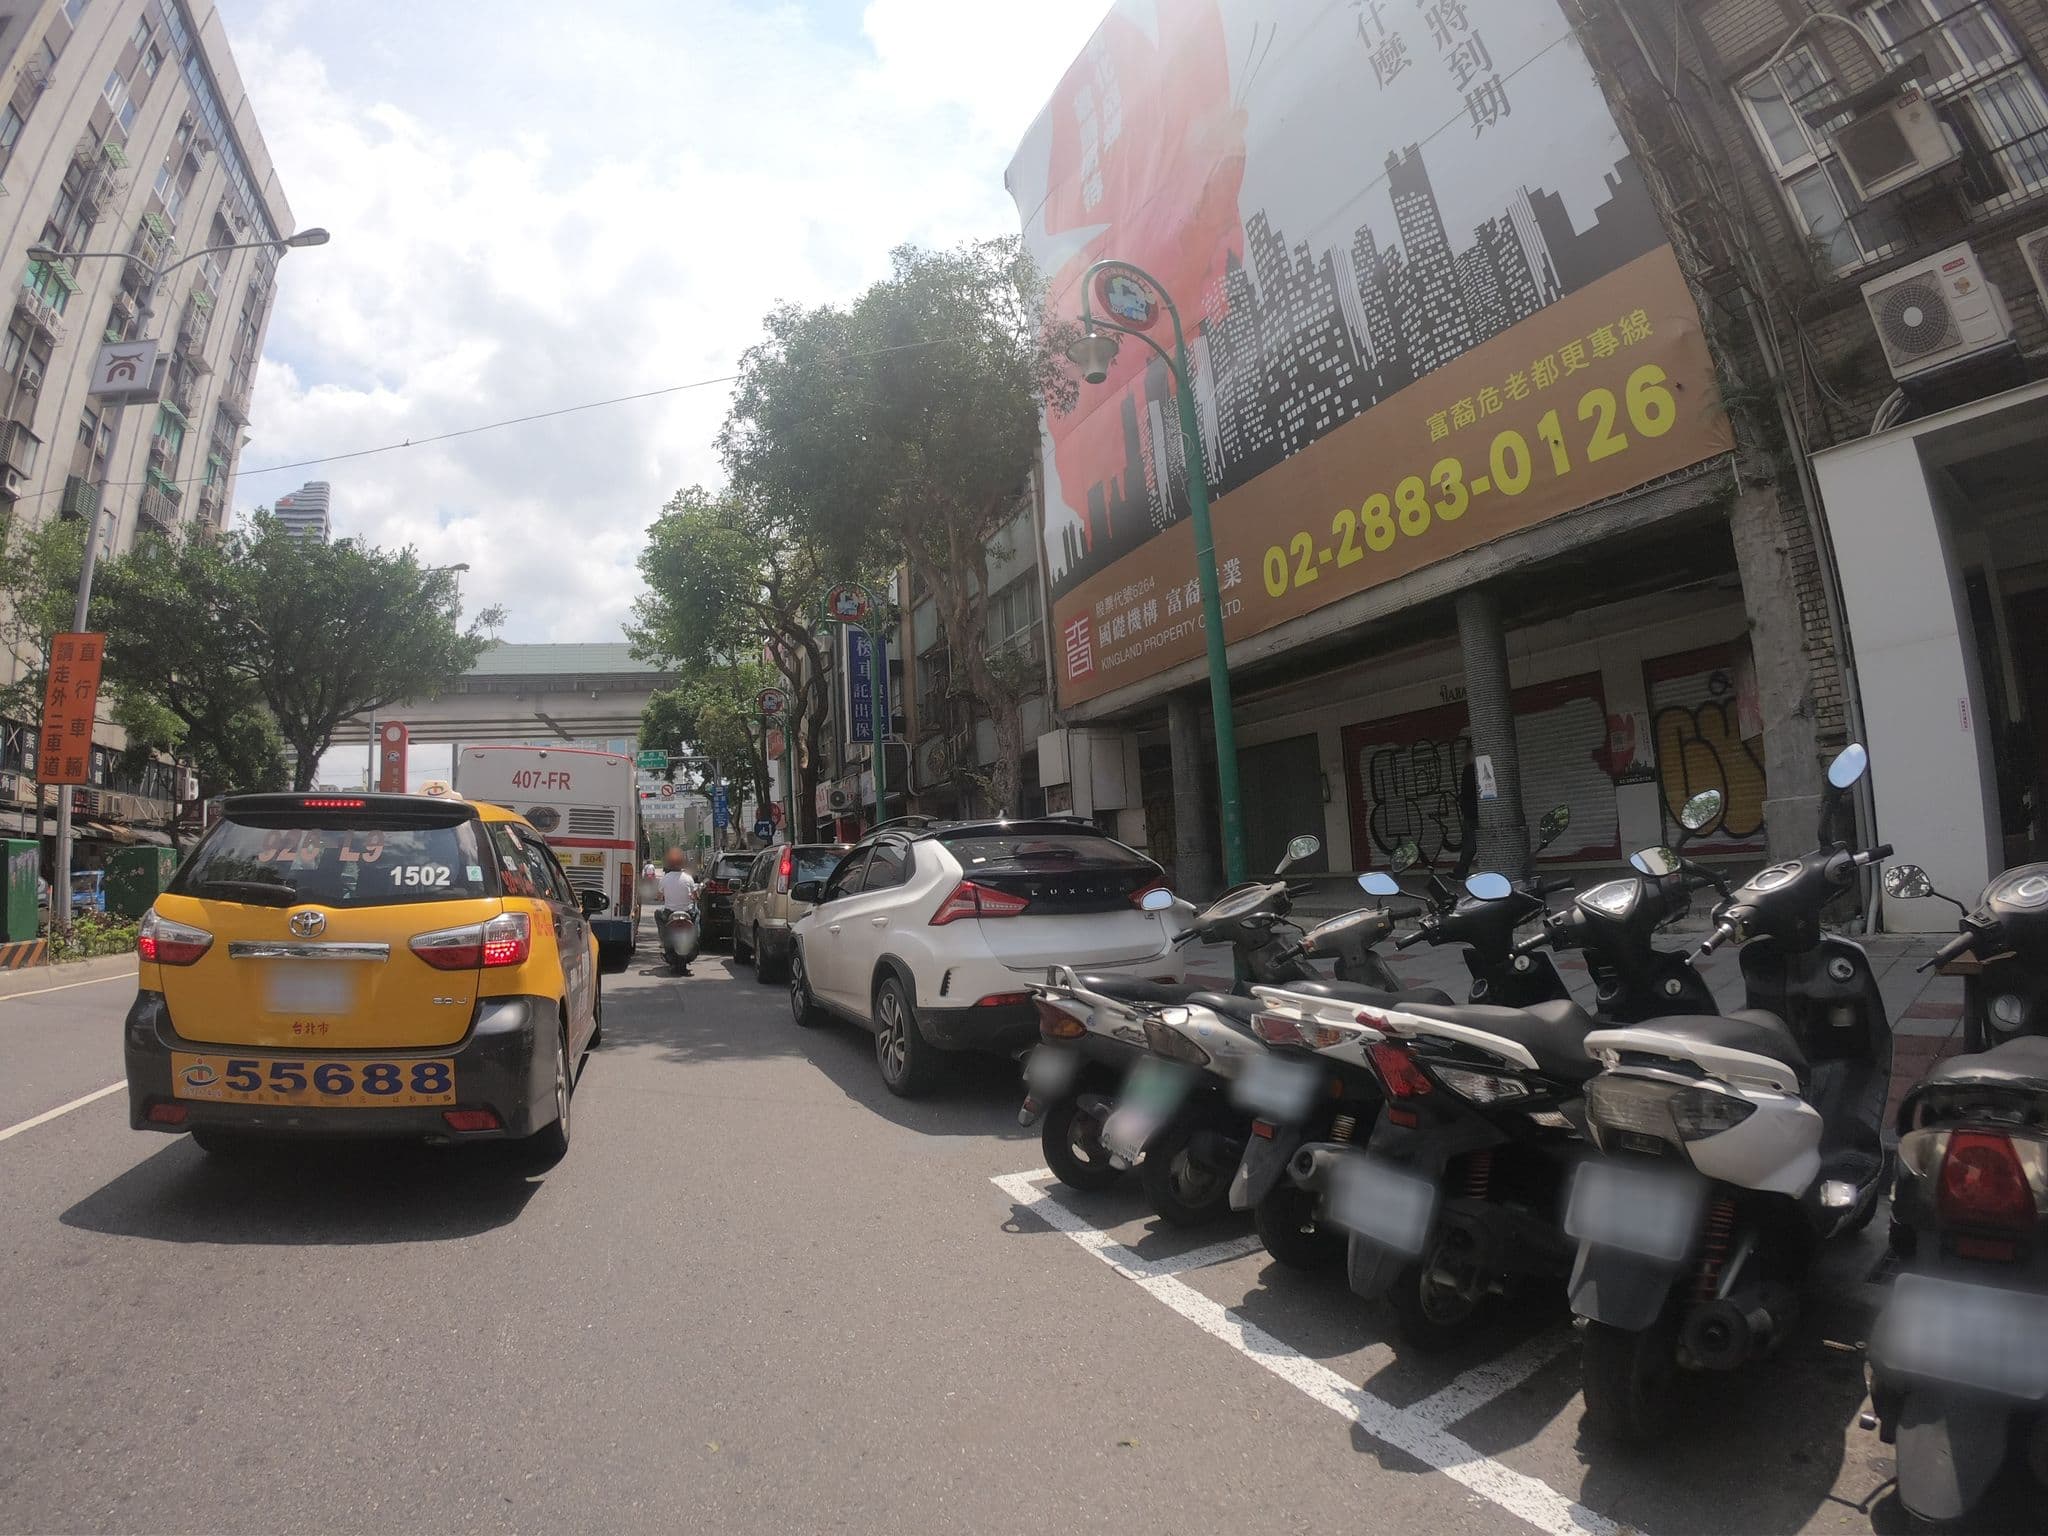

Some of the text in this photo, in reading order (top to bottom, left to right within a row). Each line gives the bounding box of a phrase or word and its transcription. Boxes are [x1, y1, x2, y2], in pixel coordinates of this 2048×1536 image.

[1348, 0, 1413, 92] 什麼
[1416, 0, 1512, 140] 將到期
[1425, 307, 1655, 444] 富裔危老都更專線
[1262, 362, 1678, 599] 02-2883-0126
[1165, 557, 1243, 617] 富裔業
[1101, 640, 1143, 671] KINGLAND
[1144, 616, 1196, 653] PROPERTY
[1220, 598, 1245, 620] LTD.
[42, 641, 74, 778] 請走外二車道
[64, 642, 97, 778] 直行車輛
[511, 769, 572, 791] 407-FR
[389, 865, 451, 887] 1502
[292, 1020, 330, 1037] 台北市
[225, 1059, 453, 1096] 55688
